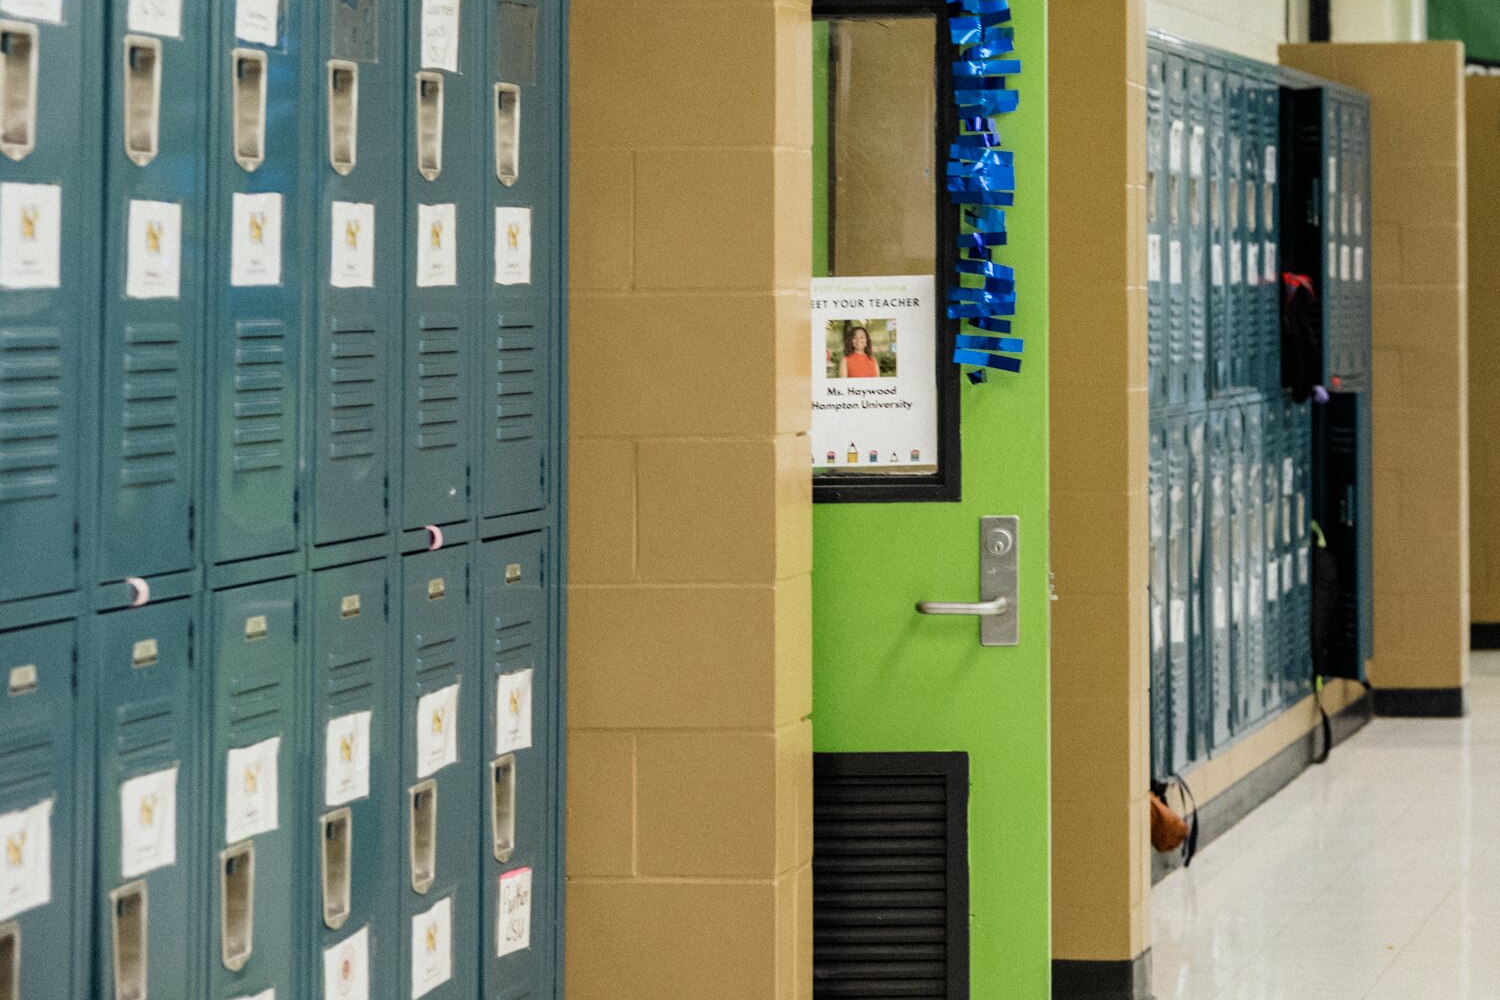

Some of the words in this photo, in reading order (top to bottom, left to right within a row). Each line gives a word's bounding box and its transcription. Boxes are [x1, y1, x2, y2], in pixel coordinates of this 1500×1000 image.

[832, 299, 865, 309] YOUR
[869, 298, 920, 308] TEACHER
[827, 387, 843, 396] Ms.
[848, 386, 897, 399] Haywood
[812, 402, 859, 412] Hampton
[861, 400, 913, 411] University
